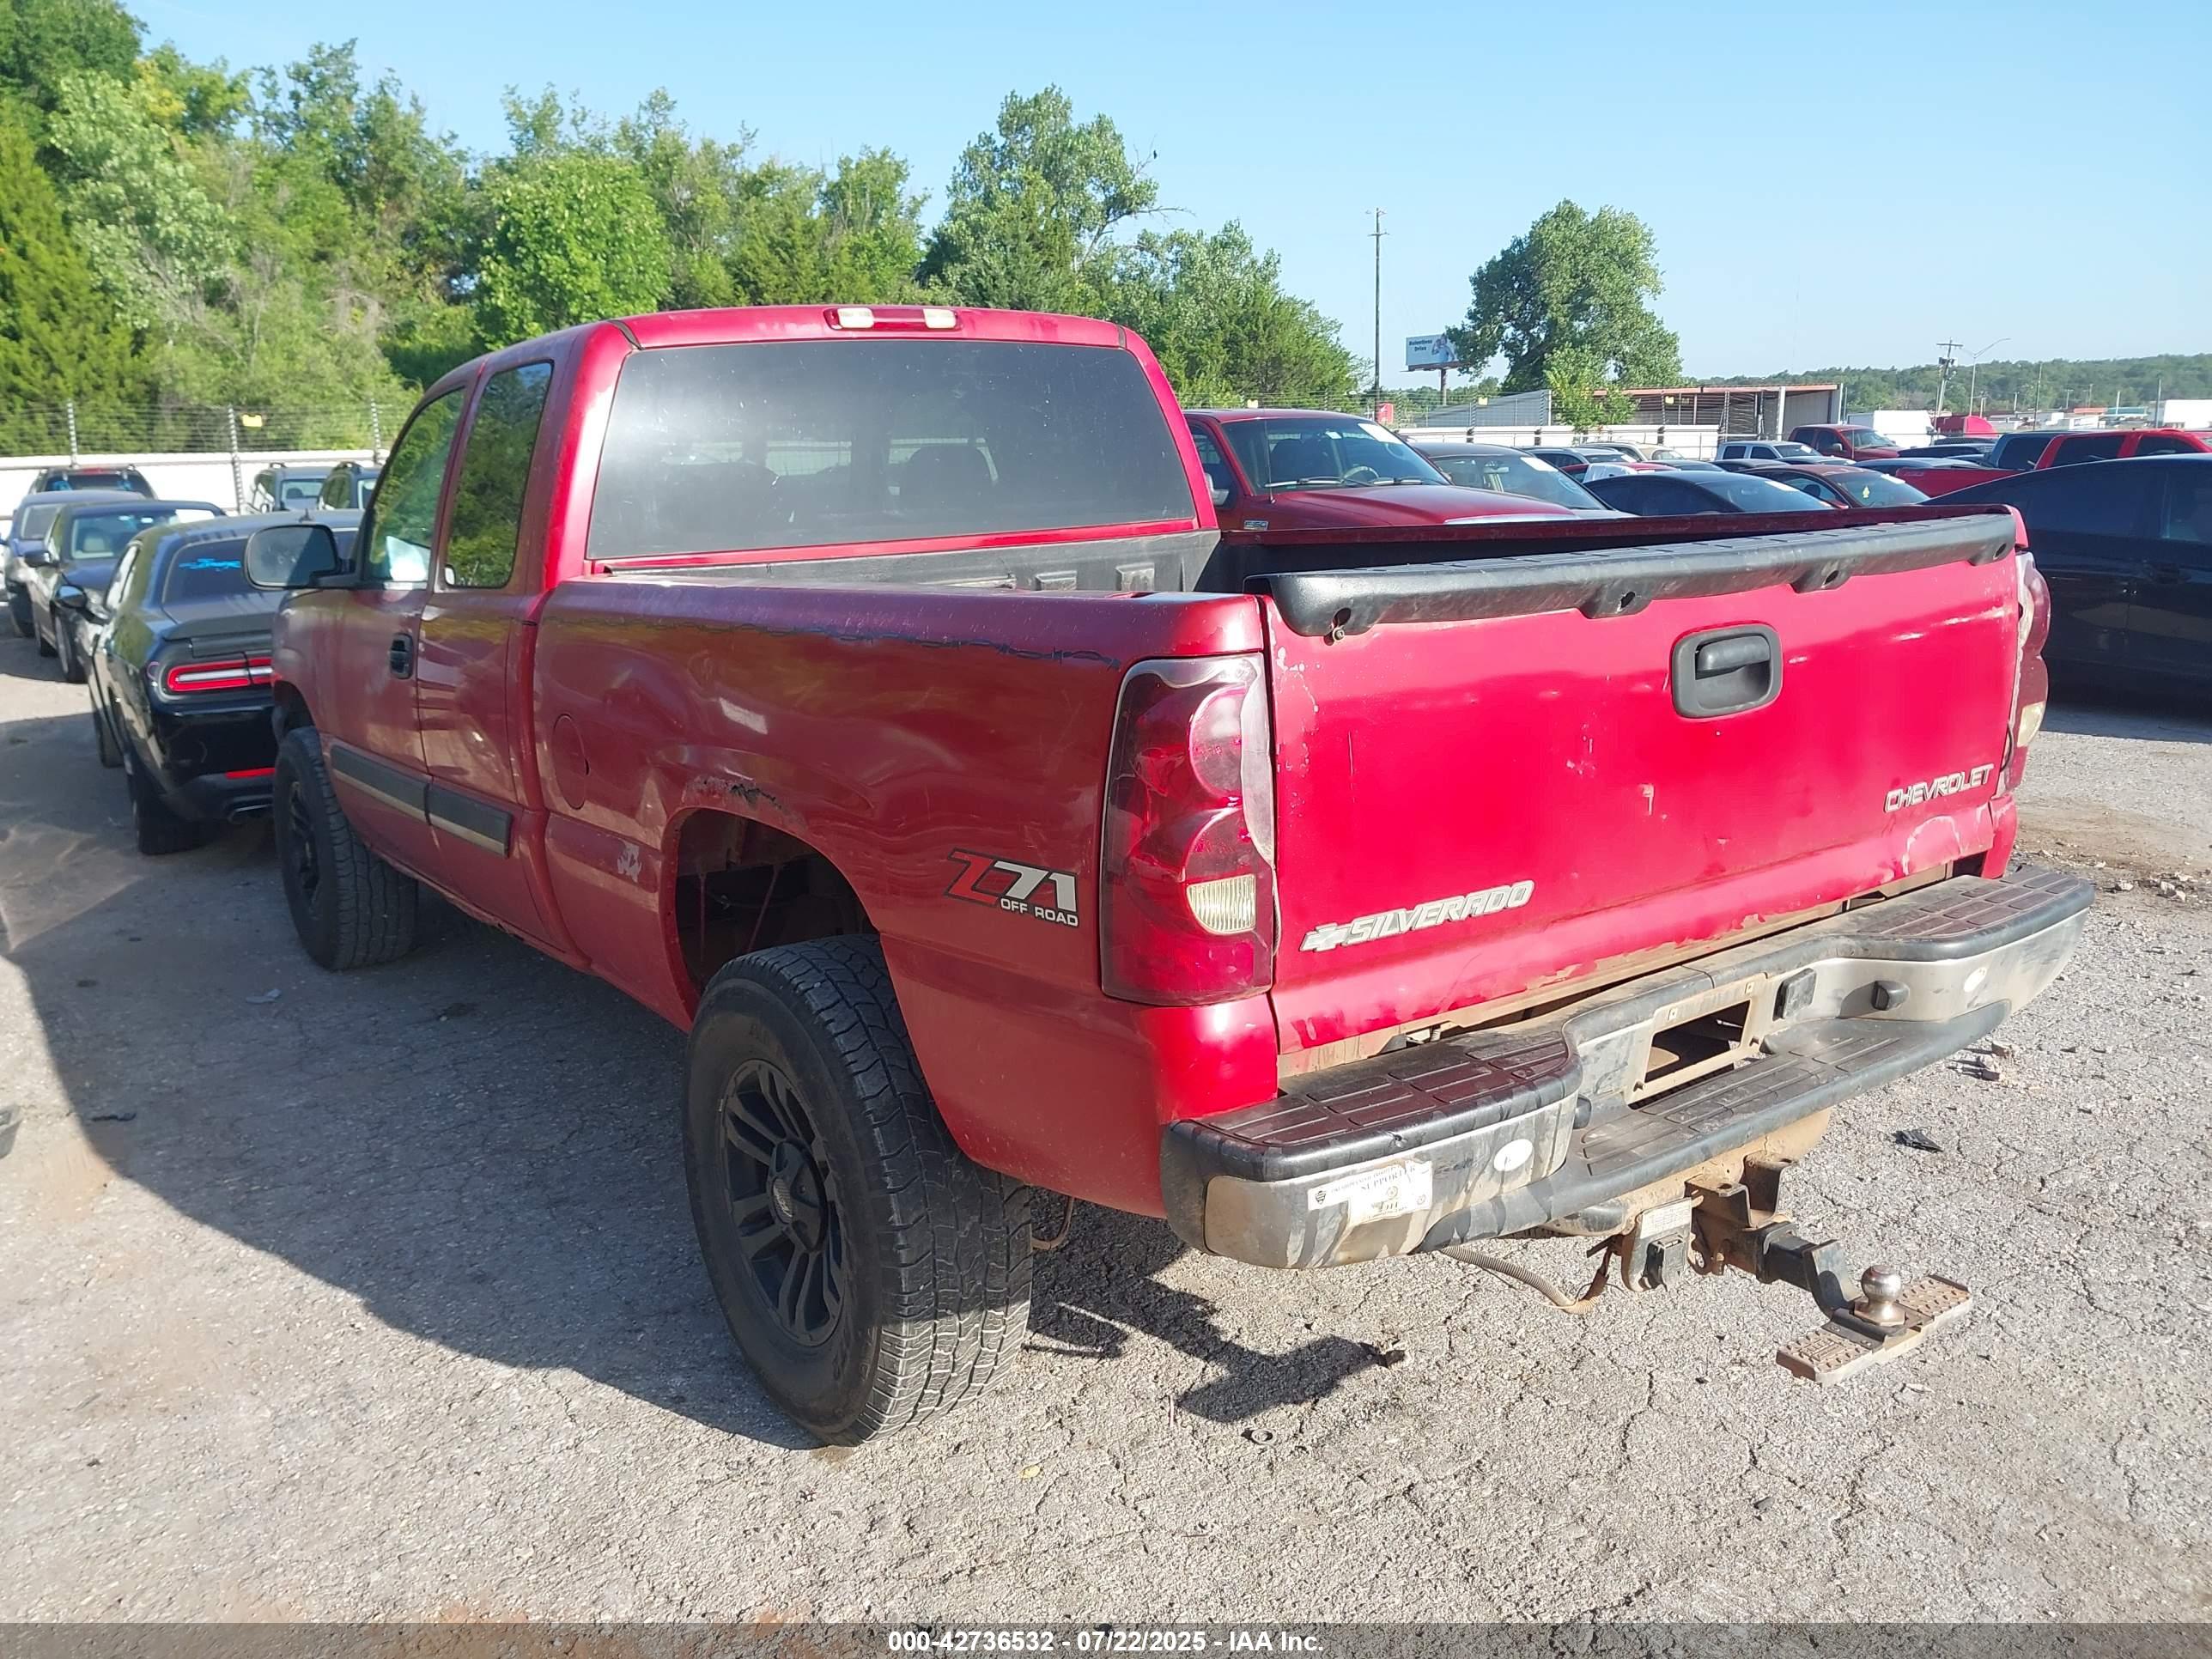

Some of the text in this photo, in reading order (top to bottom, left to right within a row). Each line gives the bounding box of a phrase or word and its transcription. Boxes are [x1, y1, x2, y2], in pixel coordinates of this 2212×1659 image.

[1884, 763, 1995, 813] CHEVROLET
[945, 848, 1078, 912] Z71
[1000, 897, 1079, 927] OFF ROAD
[1341, 879, 1535, 947] SILVERADO
